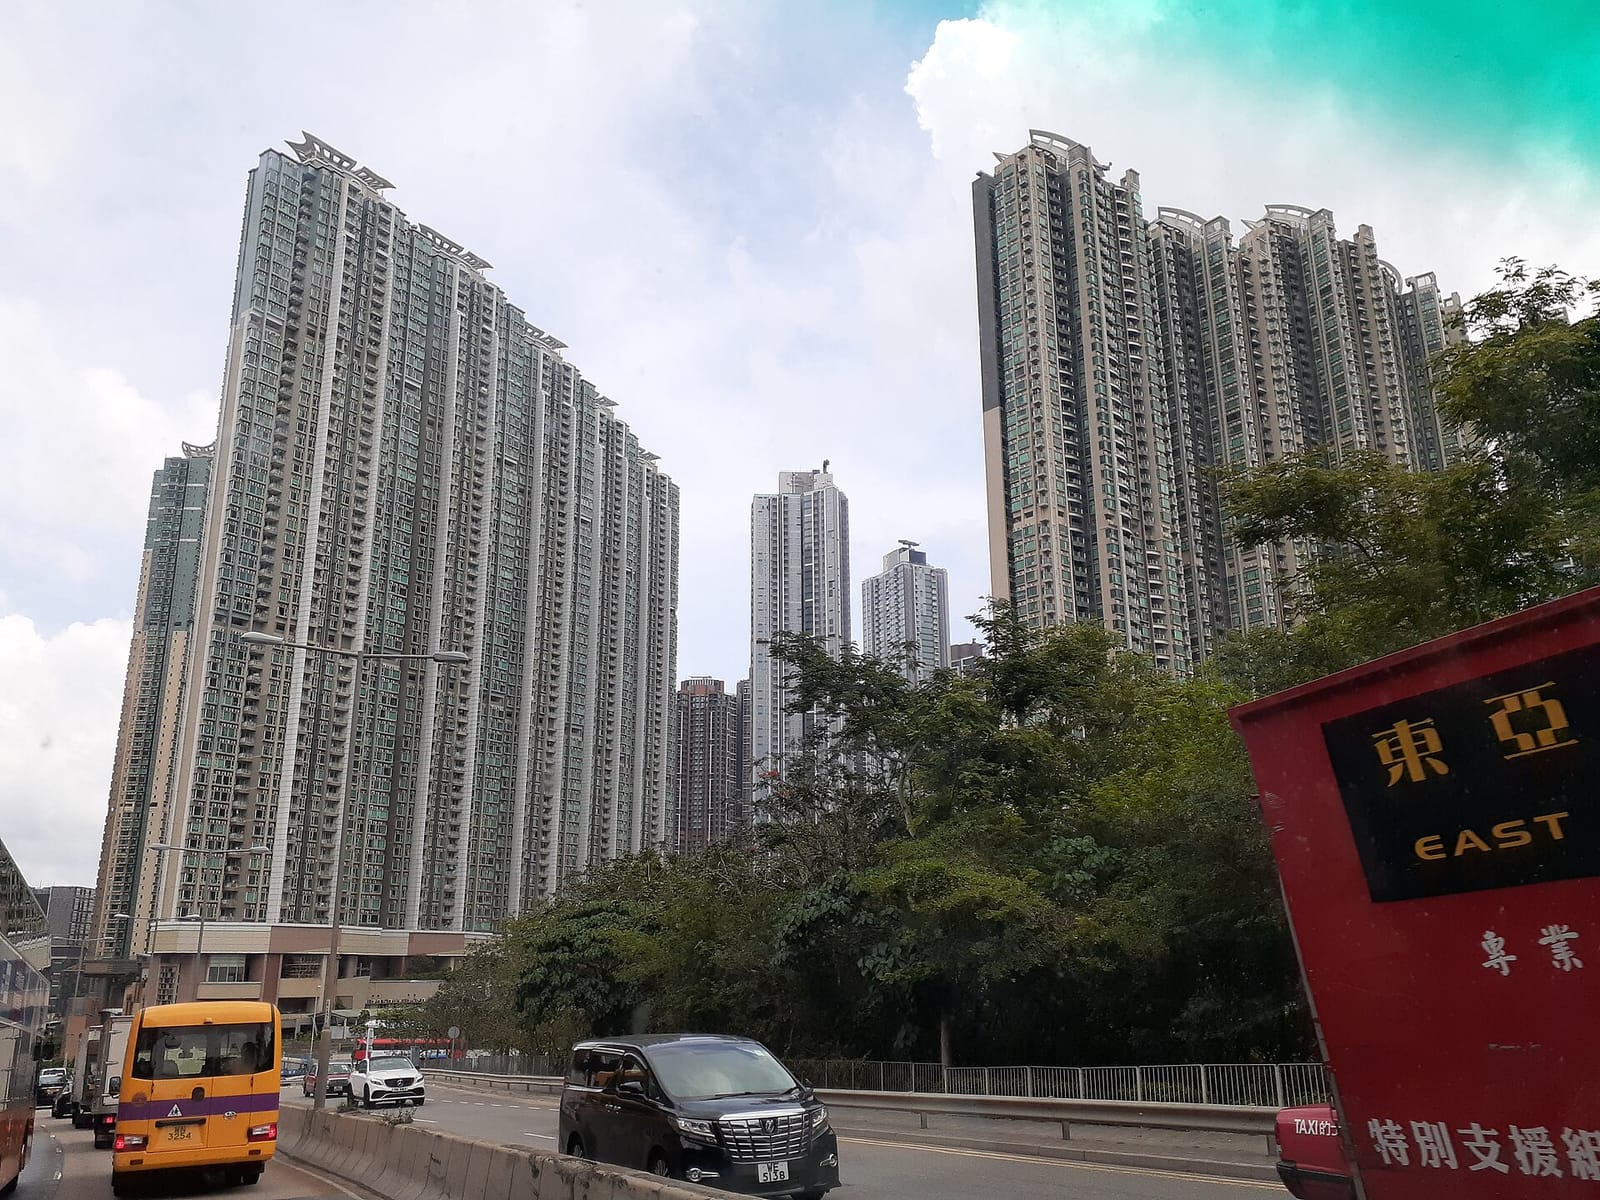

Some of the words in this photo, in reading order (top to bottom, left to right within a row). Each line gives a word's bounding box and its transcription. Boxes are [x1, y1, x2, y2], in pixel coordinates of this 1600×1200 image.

[1371, 680, 1580, 788] 東亞
[1414, 811, 1570, 861] EAST
[1294, 1118, 1319, 1135] TAXI
[168, 1132, 192, 1140] 3254
[763, 1170, 785, 1181] 5138
